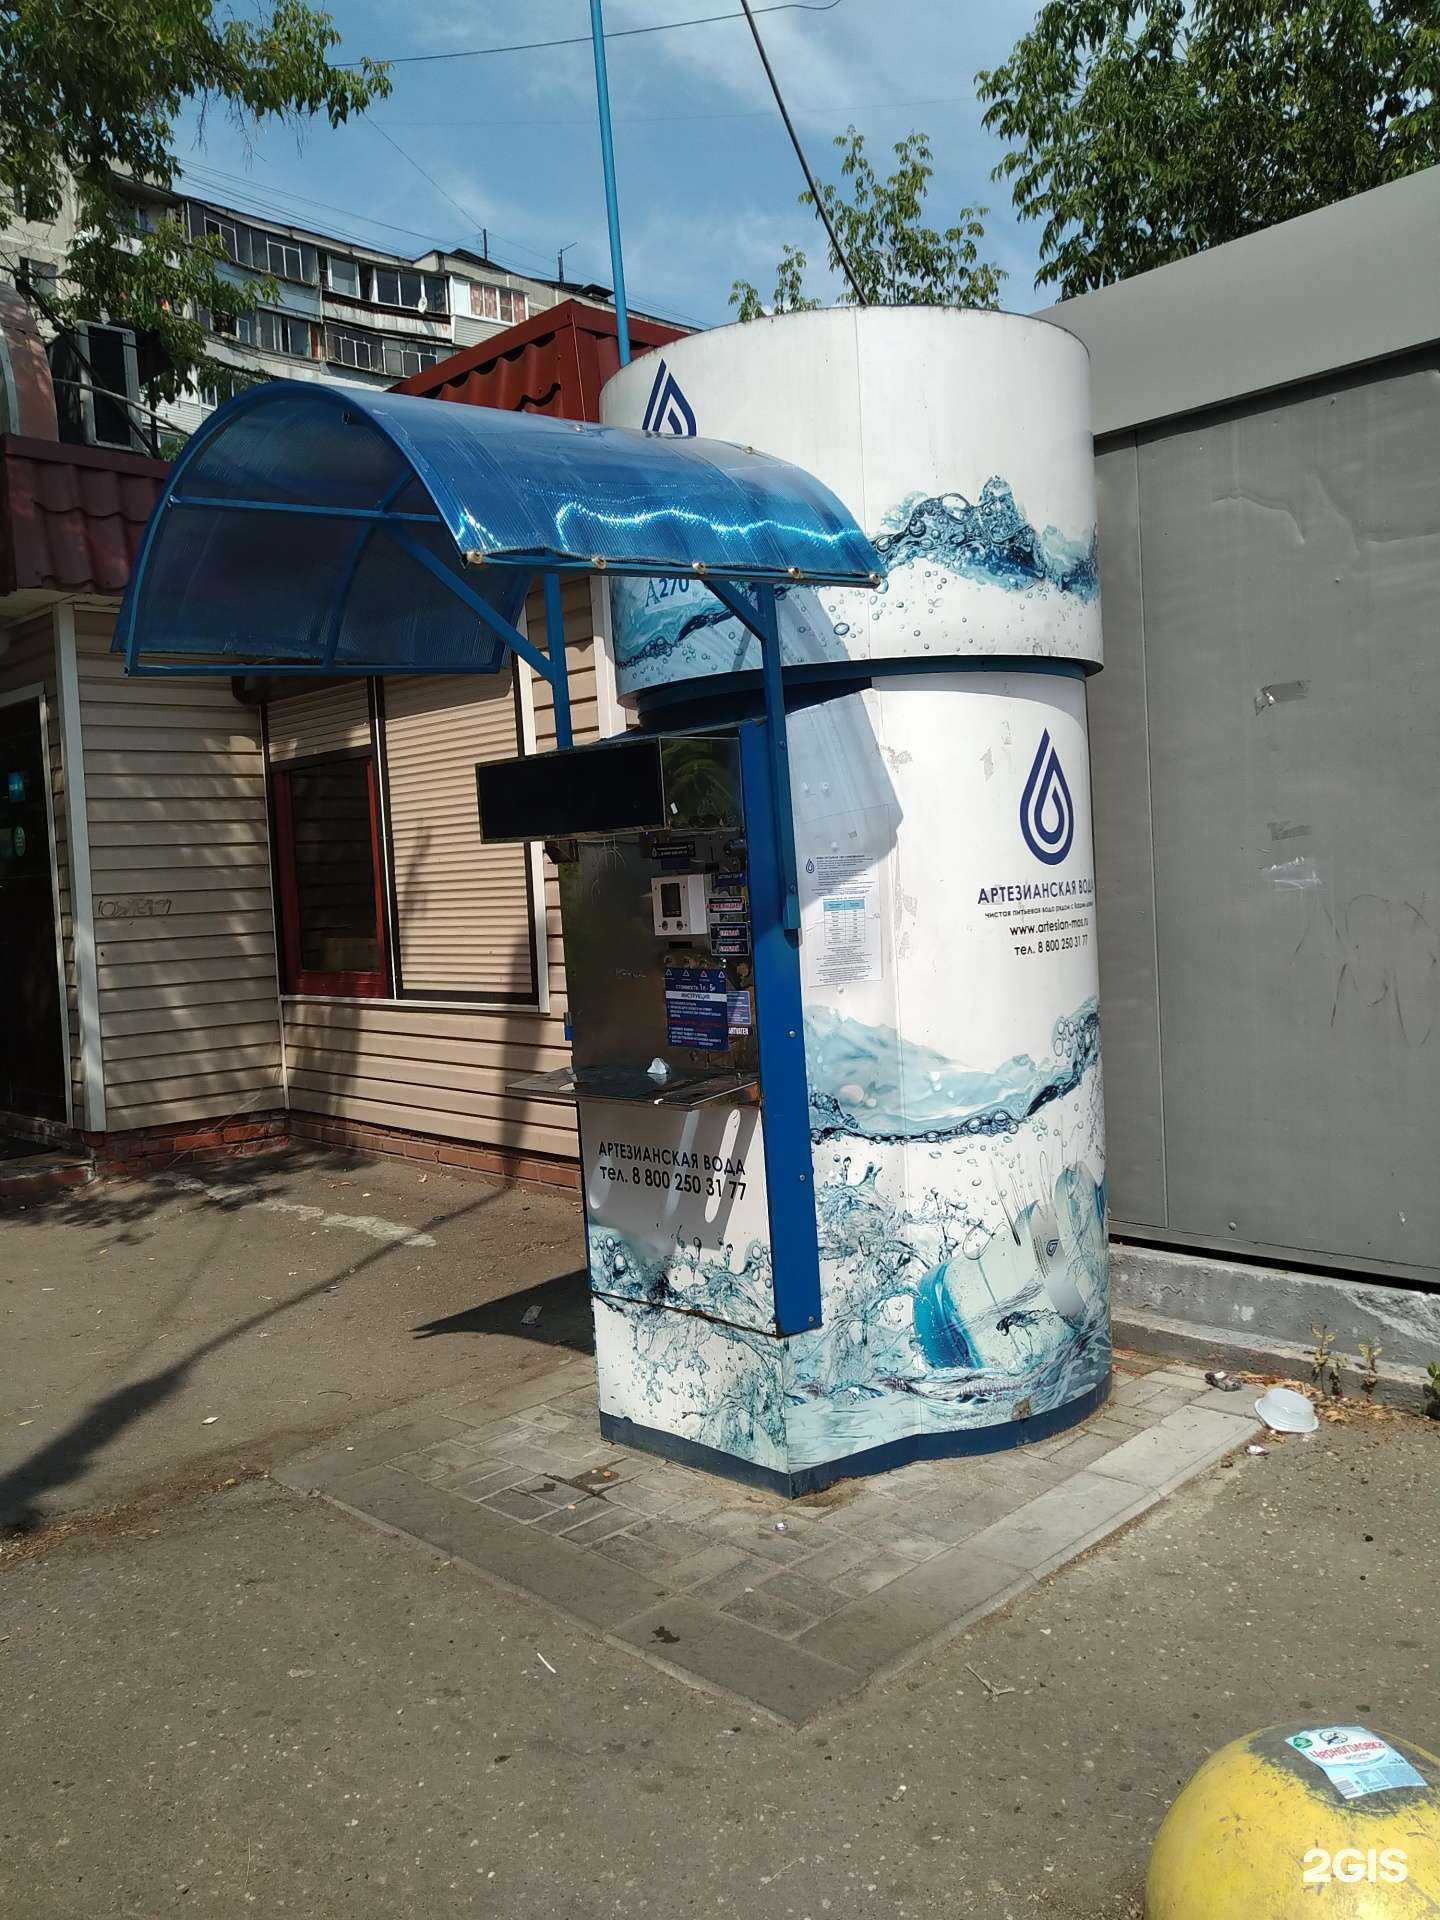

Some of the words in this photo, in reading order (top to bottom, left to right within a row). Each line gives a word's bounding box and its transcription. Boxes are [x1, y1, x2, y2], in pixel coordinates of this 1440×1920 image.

[978, 880, 1076, 904] АРТЕЗИАНСКАЯ
[985, 911, 1011, 919] чистая
[1014, 945, 1036, 955] тел.
[1037, 941, 1044, 953] 8
[1045, 939, 1060, 952] 800
[1061, 937, 1073, 950] 250
[1074, 935, 1081, 948] 31
[1082, 934, 1088, 946] 77
[598, 1141, 699, 1169] АРТЕЗИАНСКАЯ
[703, 1154, 746, 1176] ВОДА
[599, 1165, 628, 1183] тел.
[632, 1166, 641, 1185] 8
[644, 1168, 670, 1189] 800
[674, 1172, 701, 1194] 250
[705, 1177, 722, 1197] 31
[728, 1180, 747, 1200] 77
